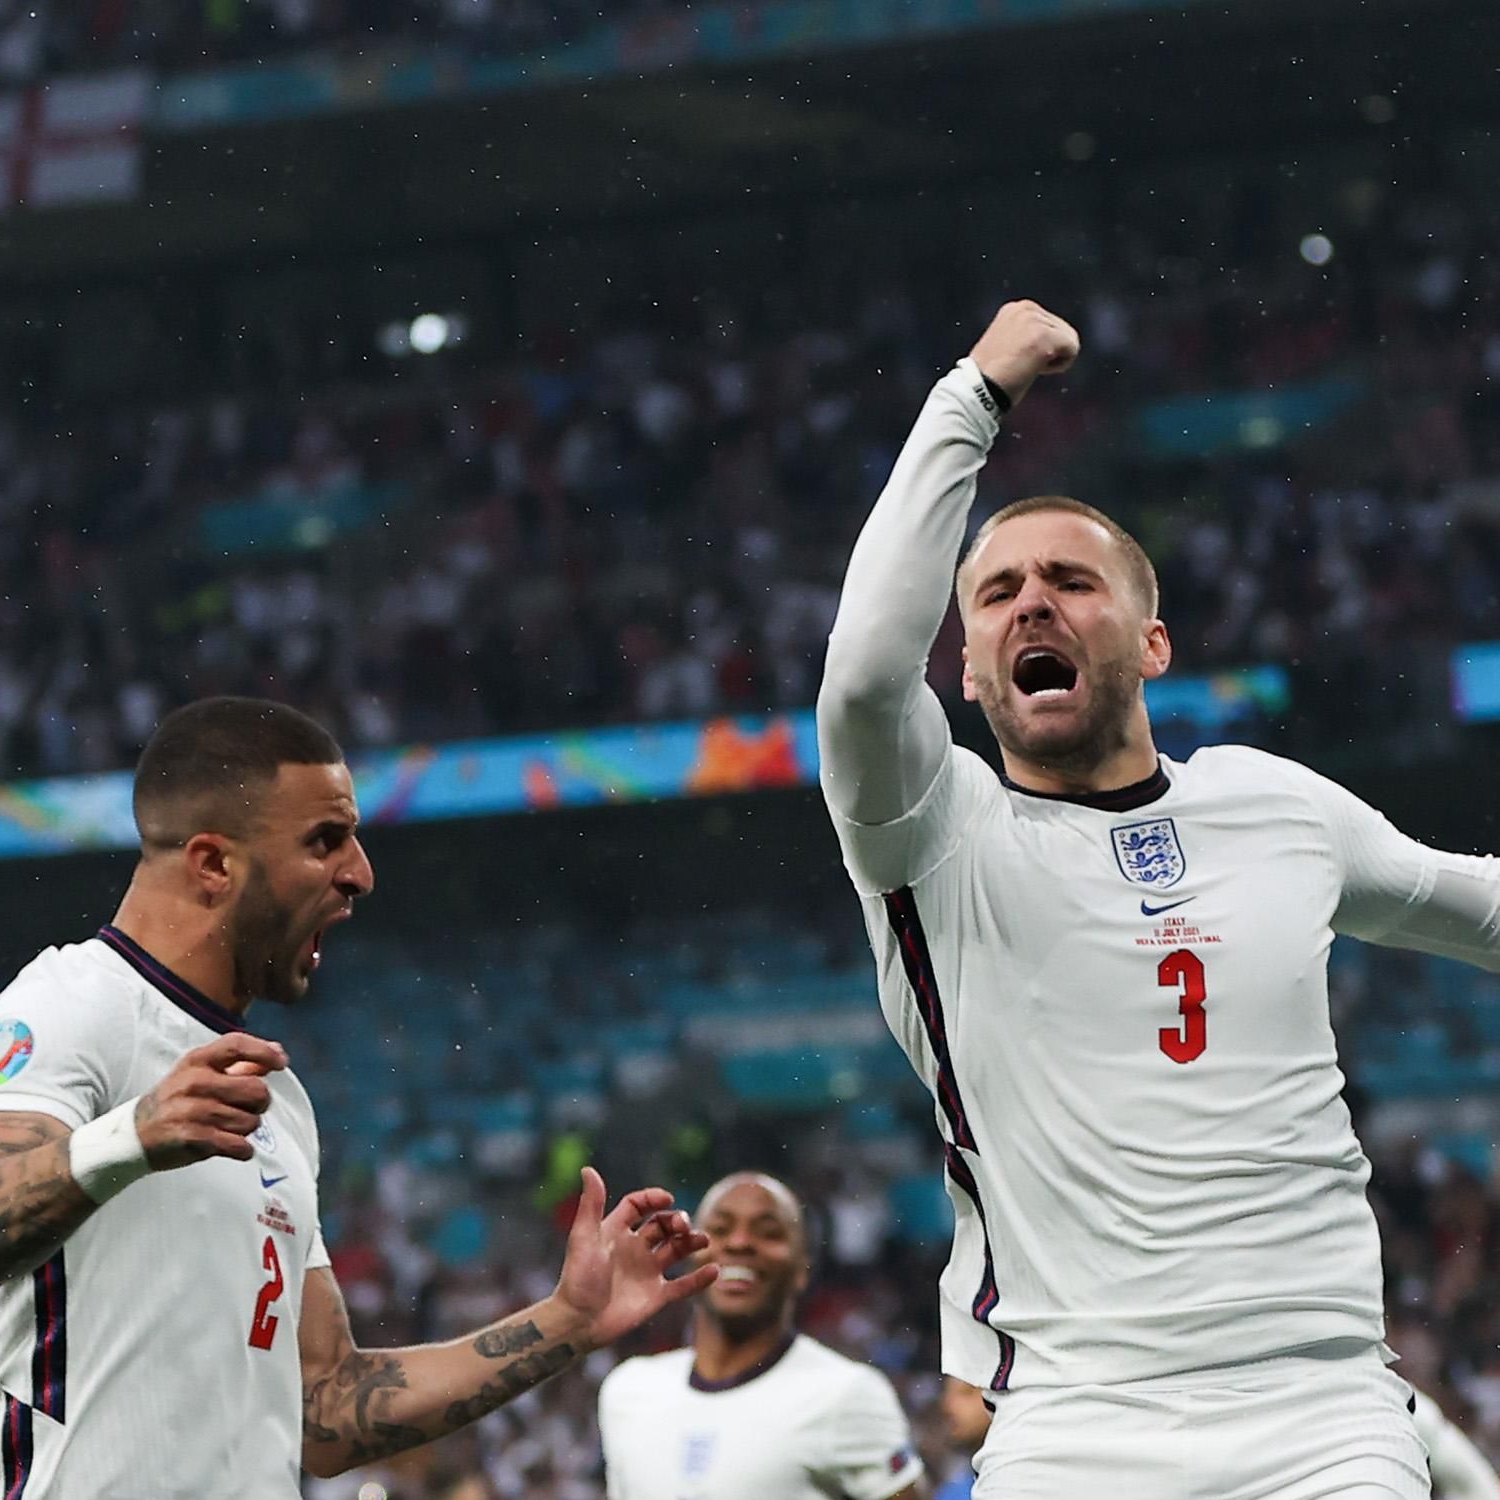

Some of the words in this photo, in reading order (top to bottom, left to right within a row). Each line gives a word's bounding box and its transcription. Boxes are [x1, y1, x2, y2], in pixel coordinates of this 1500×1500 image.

[1162, 928, 1180, 937] JULY
[1163, 917, 1186, 927] ITALY
[1158, 949, 1207, 1064] 3
[248, 1235, 285, 1351] 2
